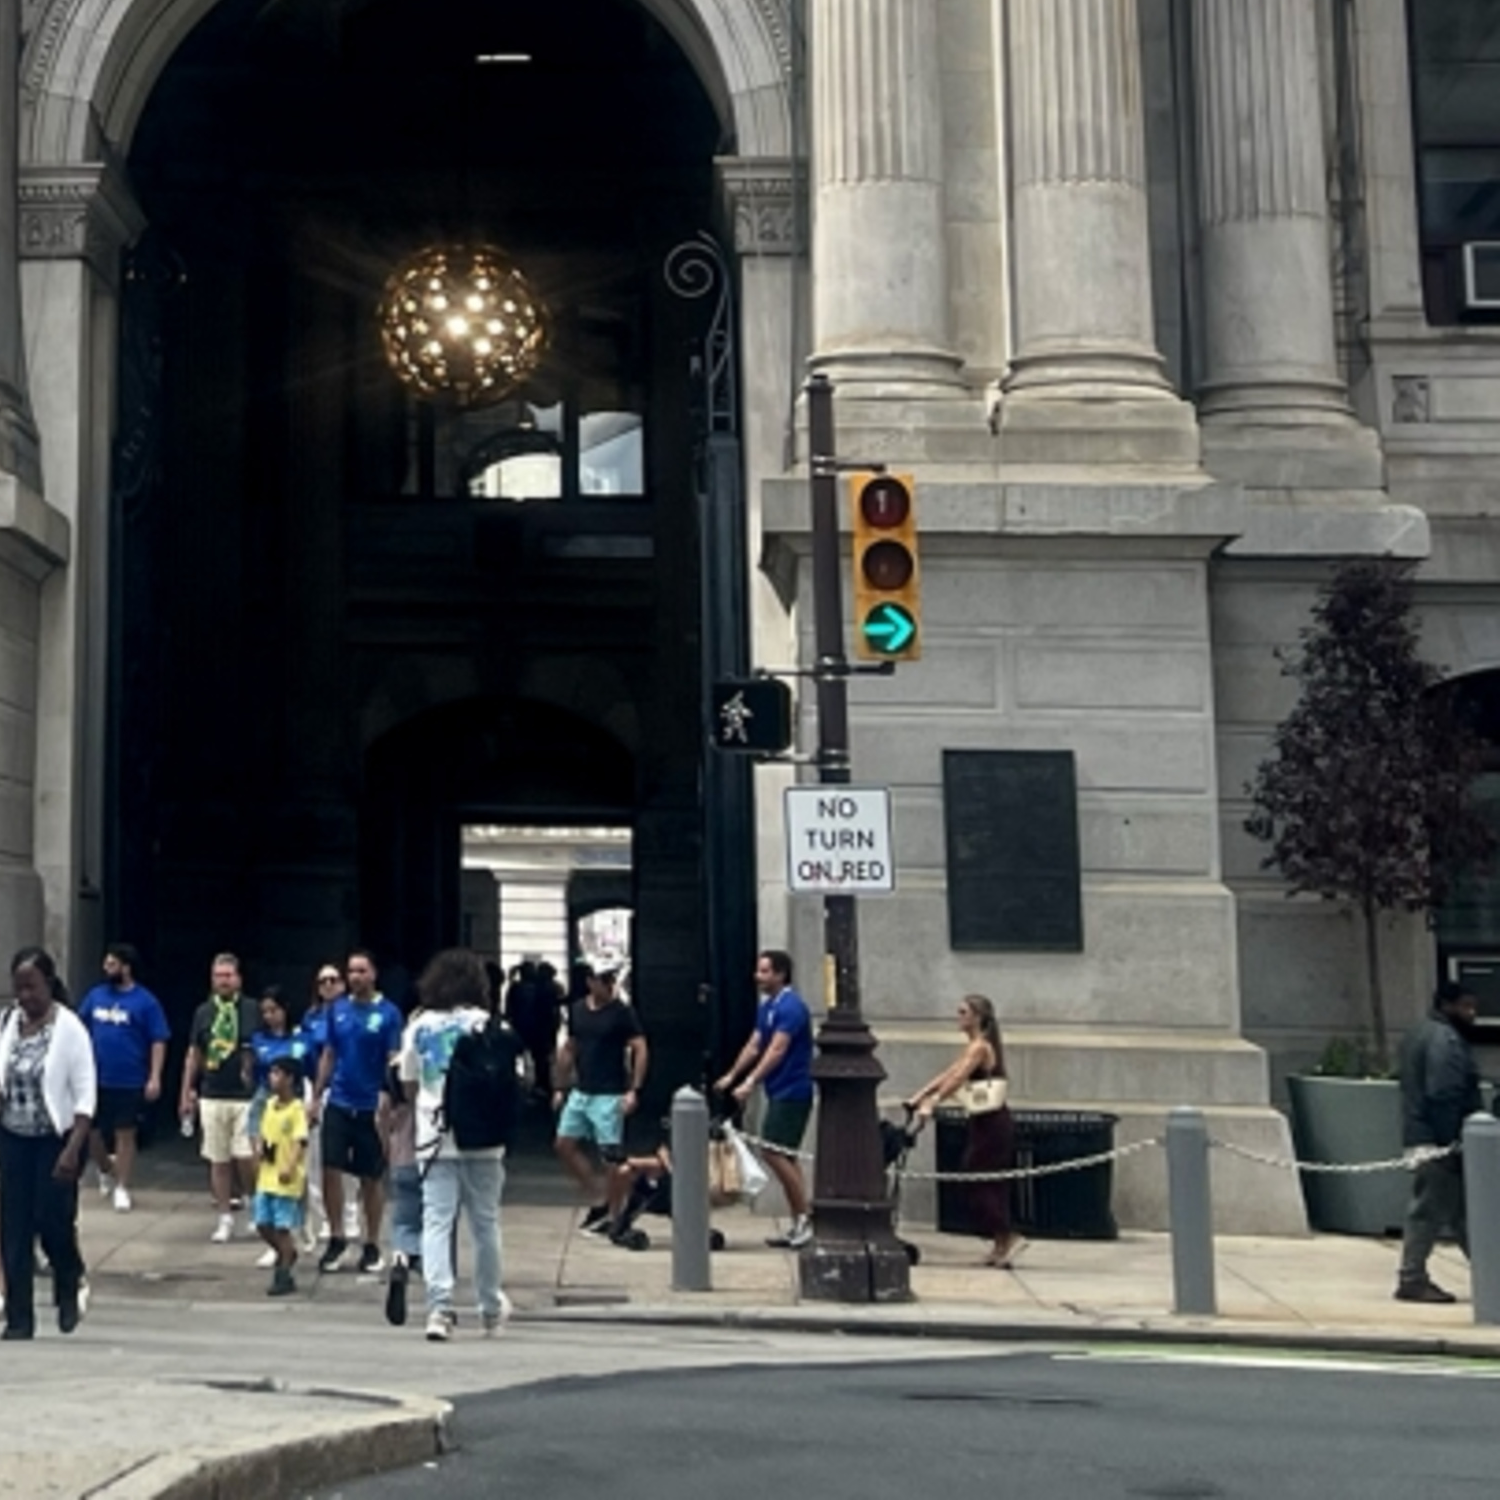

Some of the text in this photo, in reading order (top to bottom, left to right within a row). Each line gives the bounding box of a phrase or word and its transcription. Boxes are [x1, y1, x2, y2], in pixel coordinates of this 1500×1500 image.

[817, 797, 858, 819] NO
[804, 828, 875, 850] TURN
[797, 860, 885, 881] ON RED
